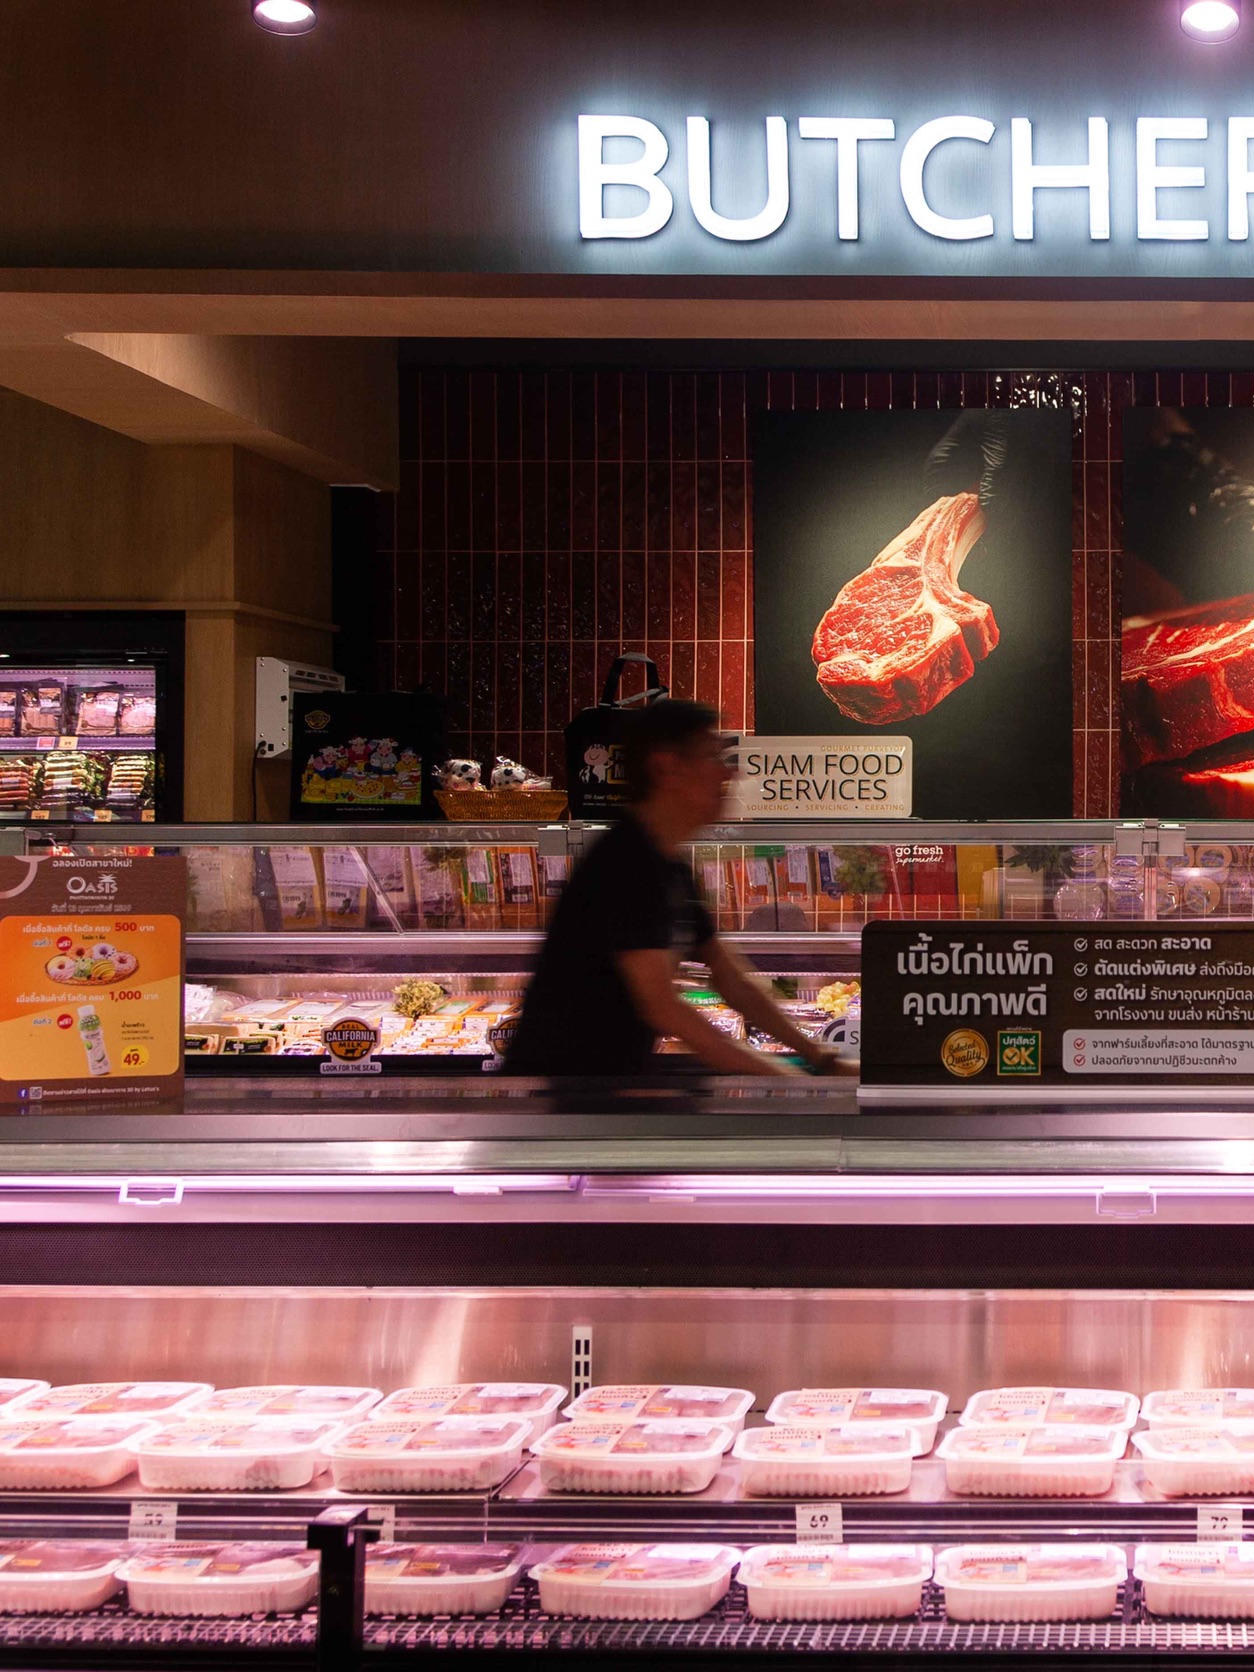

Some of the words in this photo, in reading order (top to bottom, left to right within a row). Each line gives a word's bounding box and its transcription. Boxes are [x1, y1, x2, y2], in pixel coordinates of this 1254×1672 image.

[747, 754, 813, 776] SIAM
[825, 754, 904, 776] FOOD
[762, 779, 888, 801] SERVICES
[746, 804, 789, 812] SOURCING
[805, 804, 849, 812] SERVICING
[865, 804, 905, 812] CREATING
[895, 847, 912, 858] go
[913, 845, 944, 855] fresh
[115, 922, 137, 932] 500
[1094, 939, 1113, 950] สด
[1116, 939, 1158, 950] สะดวก
[1161, 937, 1212, 950] สะอาด
[897, 932, 1053, 975] เนื้อไก่แพ็ก
[1094, 958, 1197, 976] ตัดแต่งพิเศษ
[109, 990, 142, 1002] 1,000
[1094, 983, 1147, 1000] สดใหม่
[903, 983, 1047, 1026] คุณภาพดี
[1094, 1006, 1165, 1021] จากโรงงาน
[1168, 1006, 1203, 1021] ขนส่ง
[326, 1030, 376, 1042] CALIFORNIA
[1002, 1035, 1036, 1048] ปศุสัตว์
[1092, 1035, 1199, 1050] จากฟาร์มเลี้ยงที่สะอาด
[946, 1051, 985, 1067] Quality
[1002, 1046, 1036, 1066] OK
[1091, 1054, 1237, 1068] ปลอดภัยจากยาปฏิชีวนะตกค้าง
[322, 1064, 339, 1072] LOOK
[350, 1064, 362, 1072] THE
[144, 1513, 163, 1526] 59
[810, 1514, 829, 1528] 69
[1211, 1516, 1229, 1530] 79
